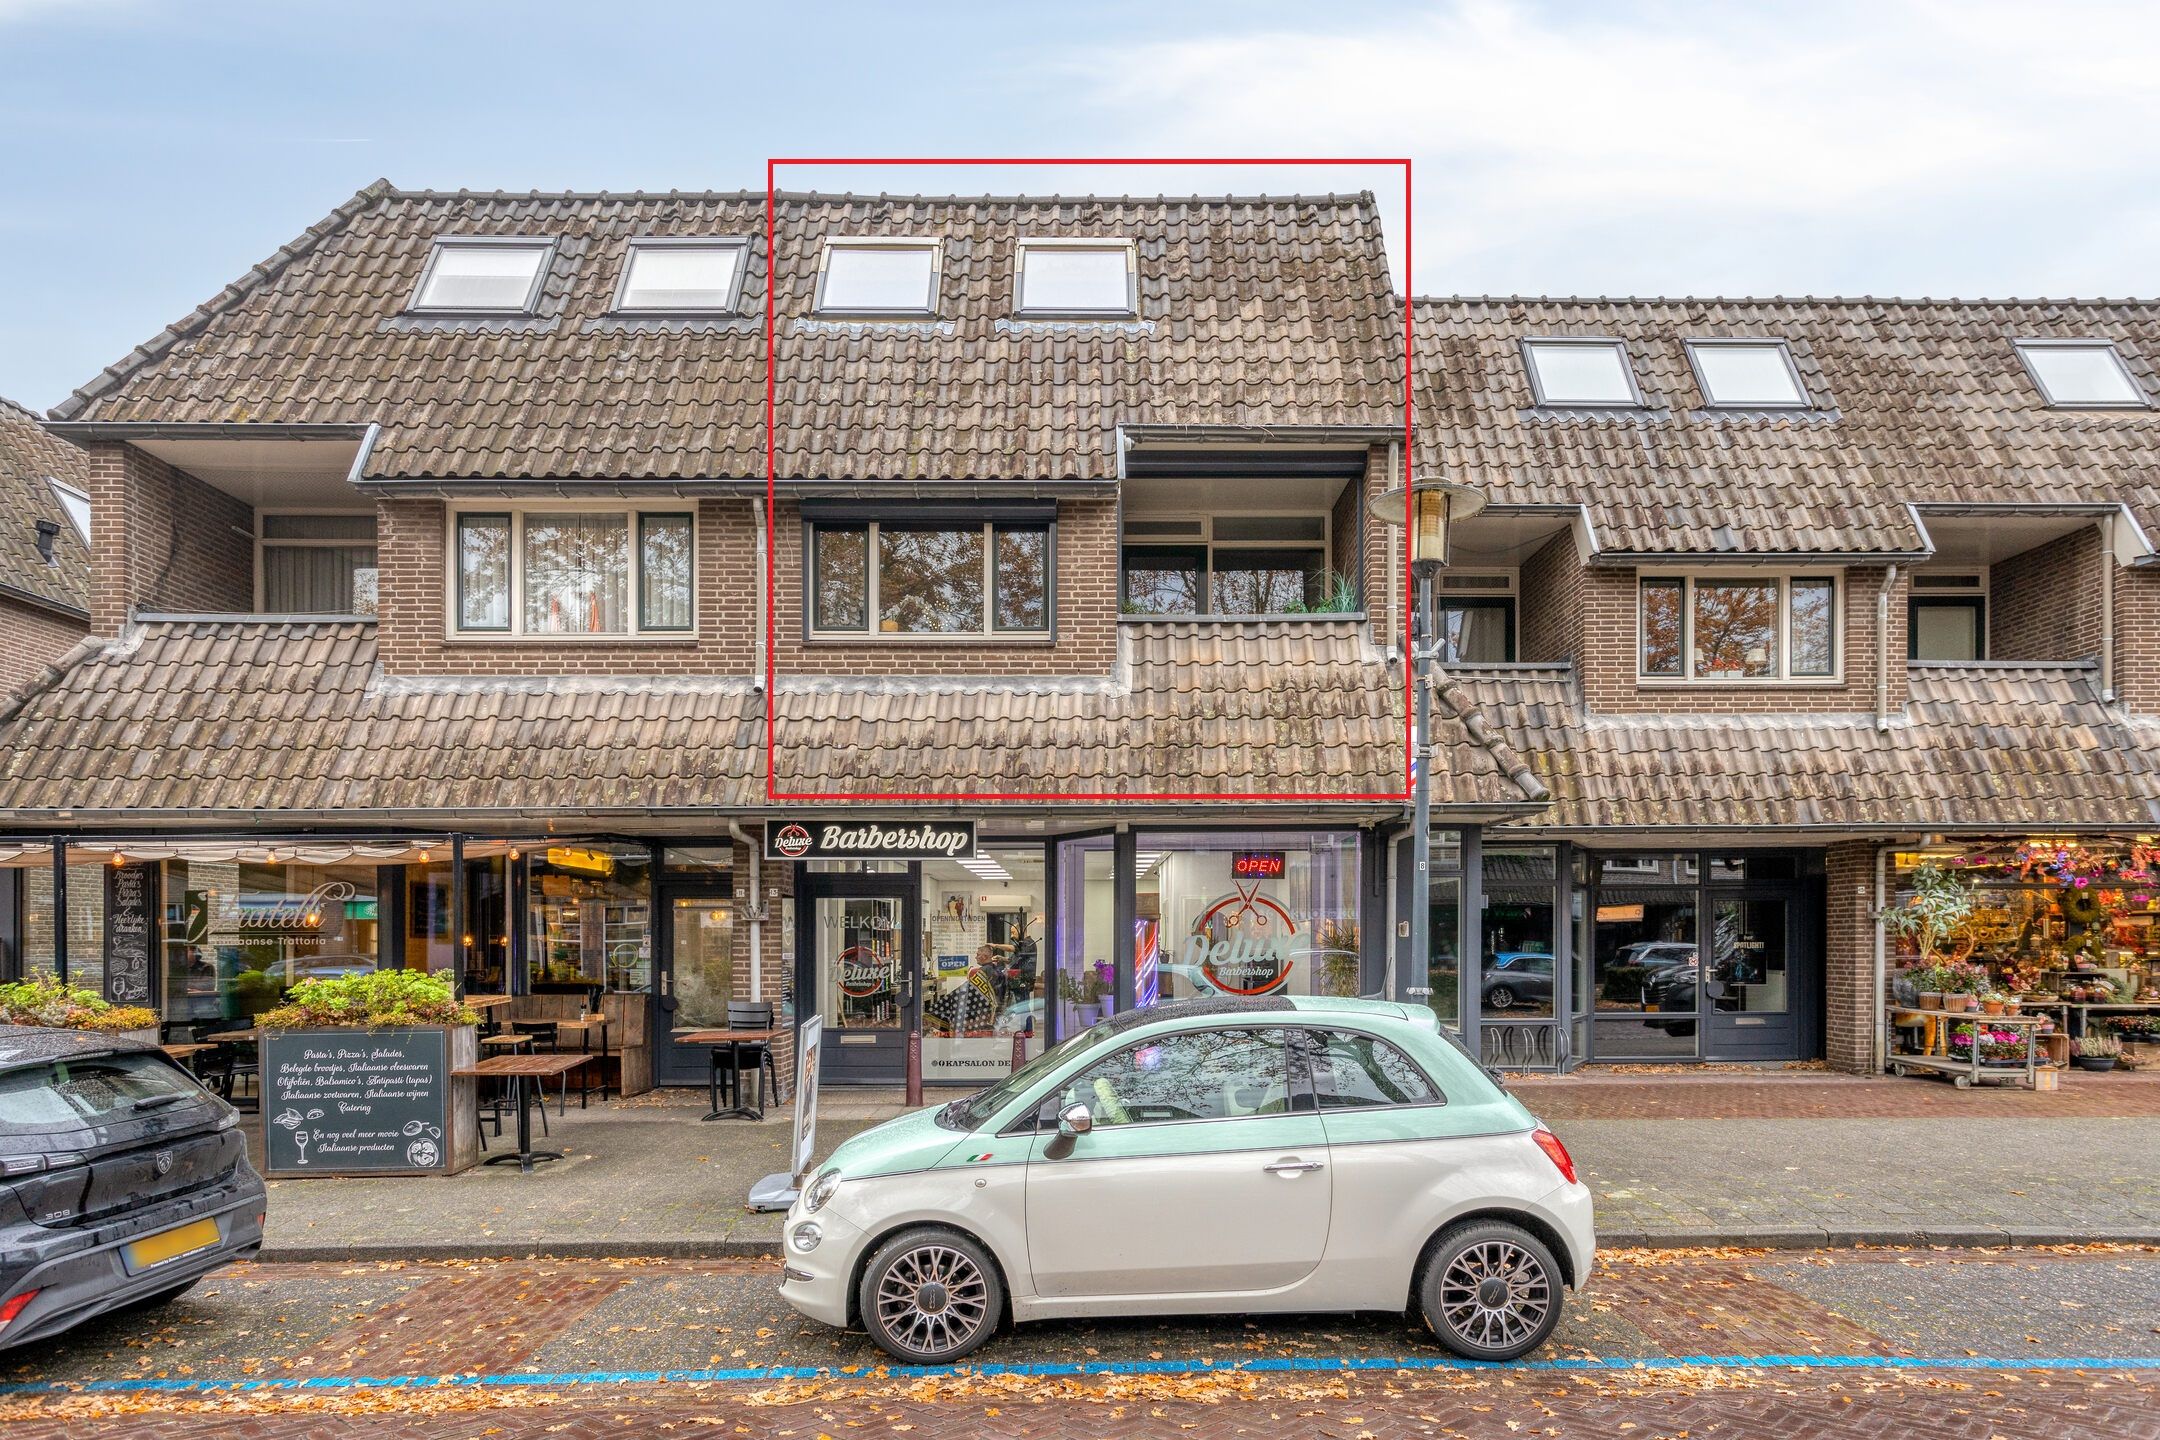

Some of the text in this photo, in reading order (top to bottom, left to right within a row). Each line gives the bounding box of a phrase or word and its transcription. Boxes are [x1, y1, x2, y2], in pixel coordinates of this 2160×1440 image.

[774, 824, 968, 856] Deluxe Barbershop
[1237, 860, 1281, 872] OPEN
[185, 882, 356, 944] Fratelli
[277, 937, 326, 946] Trattoria
[1183, 931, 1310, 967] Deluxe
[1219, 967, 1274, 978] Barbershop
[303, 1049, 335, 1060] Pasta's,
[337, 1048, 369, 1059] Pizza's,
[280, 1061, 429, 1076] Belegde broodjes, Italiaanse vleeswaren
[366, 1075, 404, 1087] Antipasti
[405, 1074, 433, 1087] (tapas)
[281, 1089, 321, 1100] Italiaanse
[364, 1089, 405, 1099] Italiaanse
[406, 1090, 429, 1101] wijnen
[338, 1101, 372, 1115] Catering
[313, 1128, 400, 1142] En nog veel meer mooie
[317, 1143, 395, 1155] Italiaanse producten
[45, 1209, 70, 1220] 308
